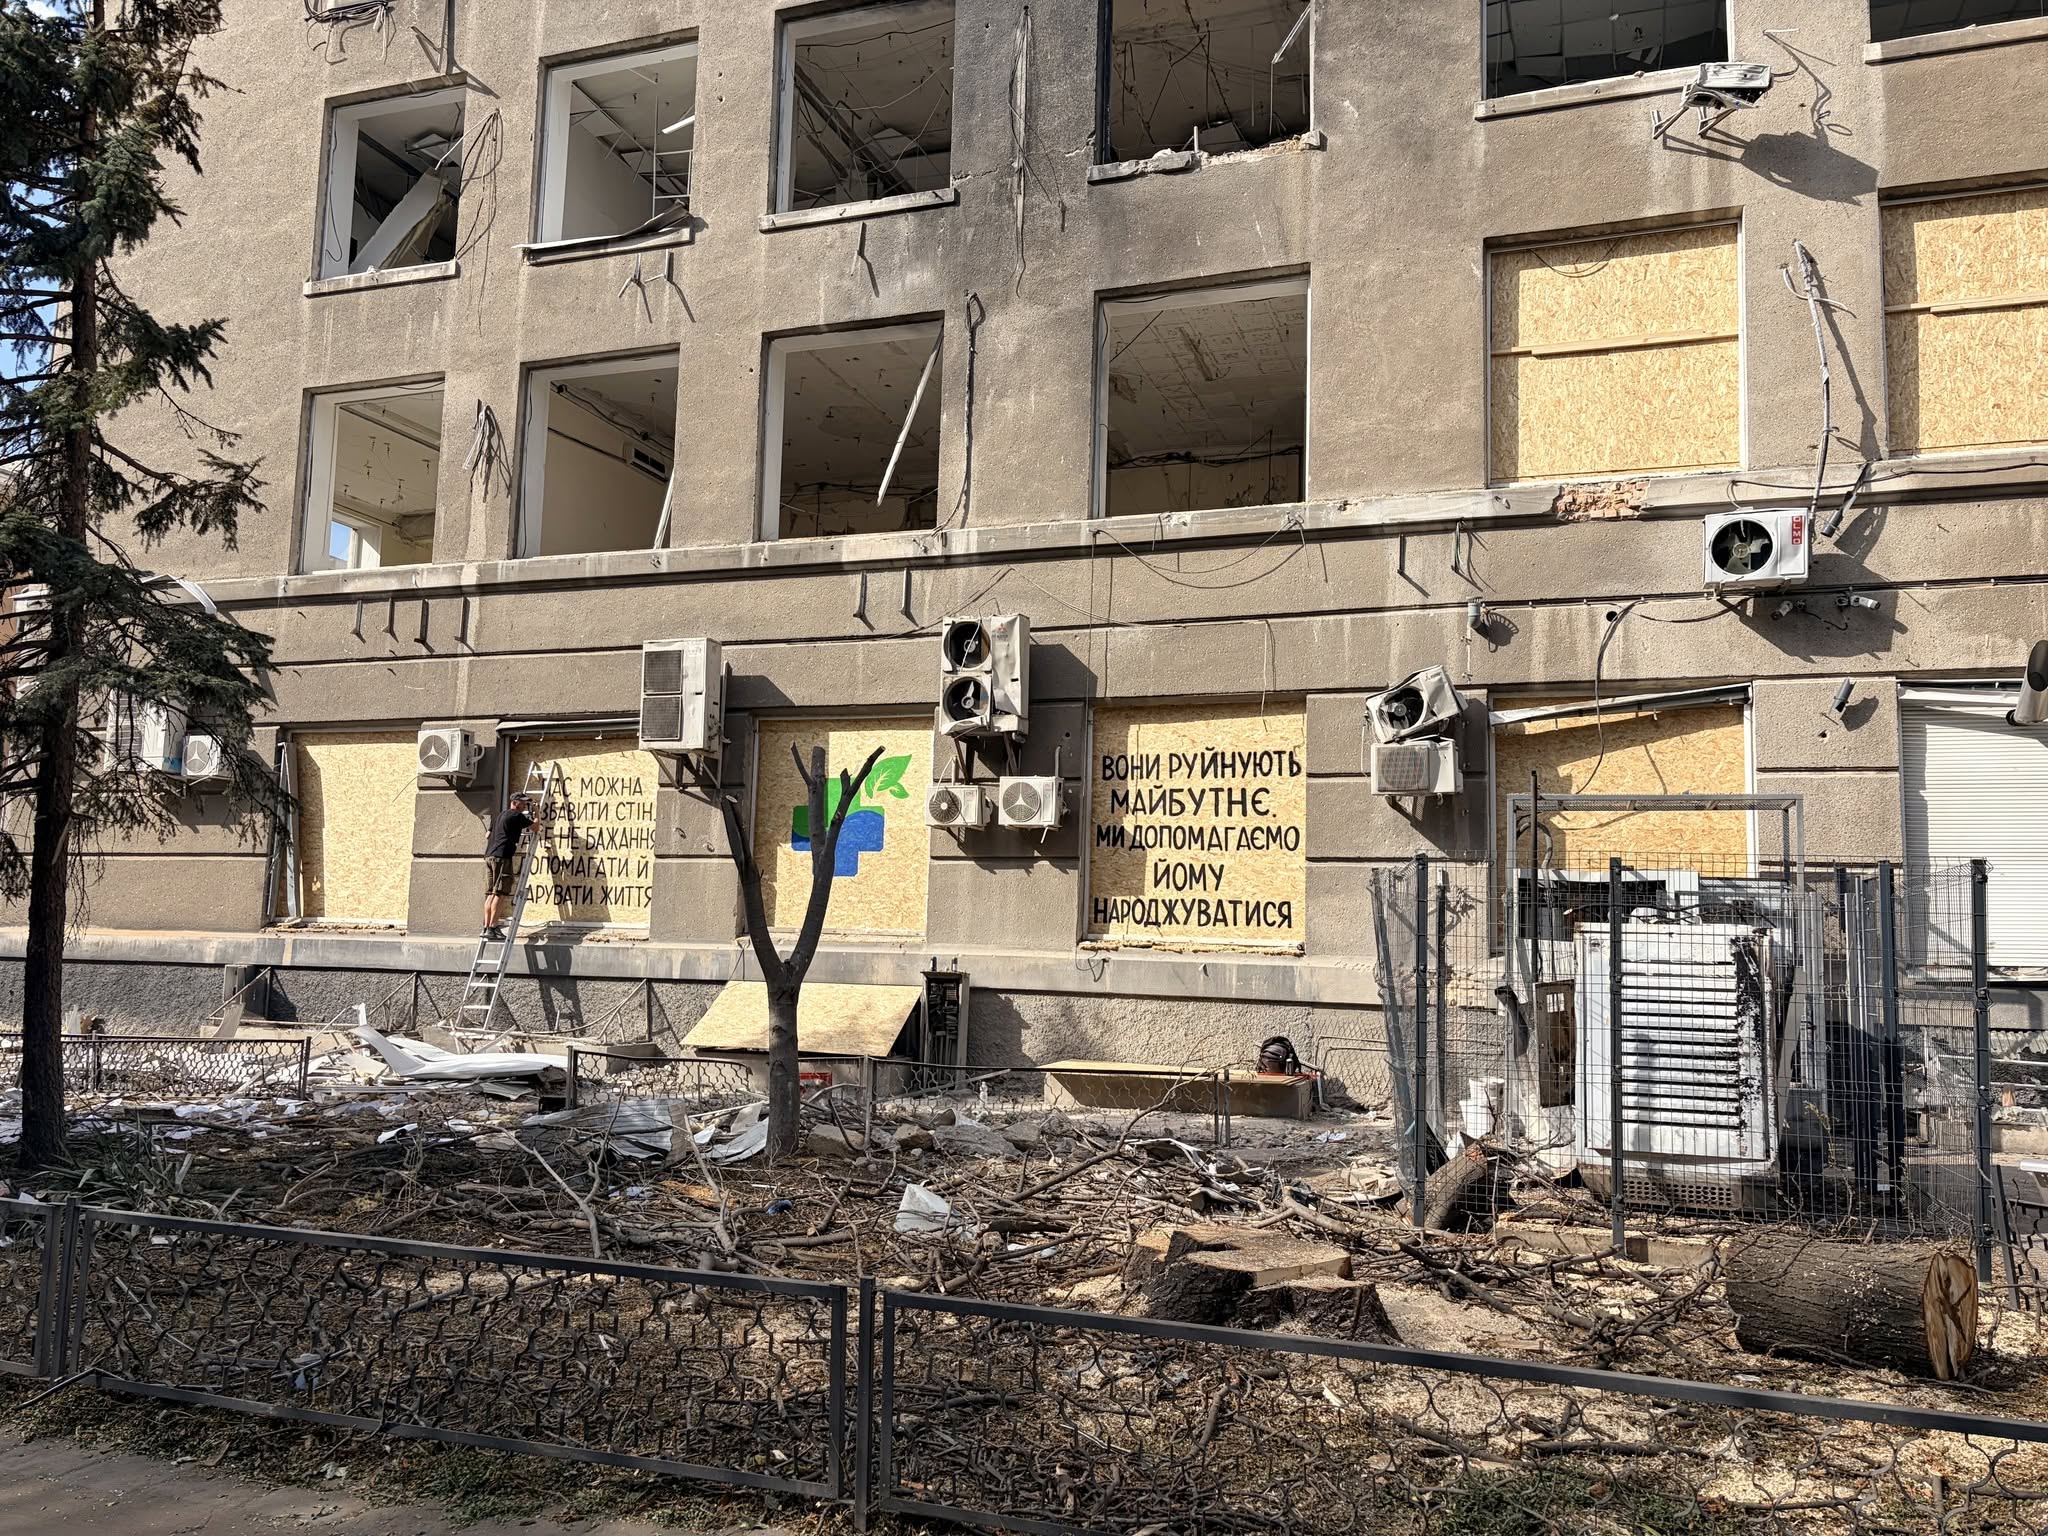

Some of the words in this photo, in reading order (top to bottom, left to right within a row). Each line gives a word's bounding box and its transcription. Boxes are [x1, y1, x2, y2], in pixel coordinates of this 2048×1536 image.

[1792, 516, 1801, 544] OLMO
[1102, 754, 1160, 781] ВОНИ
[1169, 746, 1302, 779] РУЙНУЮТЬ
[580, 777, 643, 797] МОЖНА
[1111, 785, 1277, 818] МАЙБУТНЄ.
[559, 827, 580, 849] НЕ
[1096, 825, 1125, 847] МИ
[1129, 825, 1300, 851] ДОПОМАГАЄМО
[637, 855, 649, 879] Й
[1153, 858, 1225, 891] ЙОМУ
[512, 884, 593, 906] АРУВАТИ
[1093, 897, 1293, 928] НАРОДЖУВАТИСЯ
